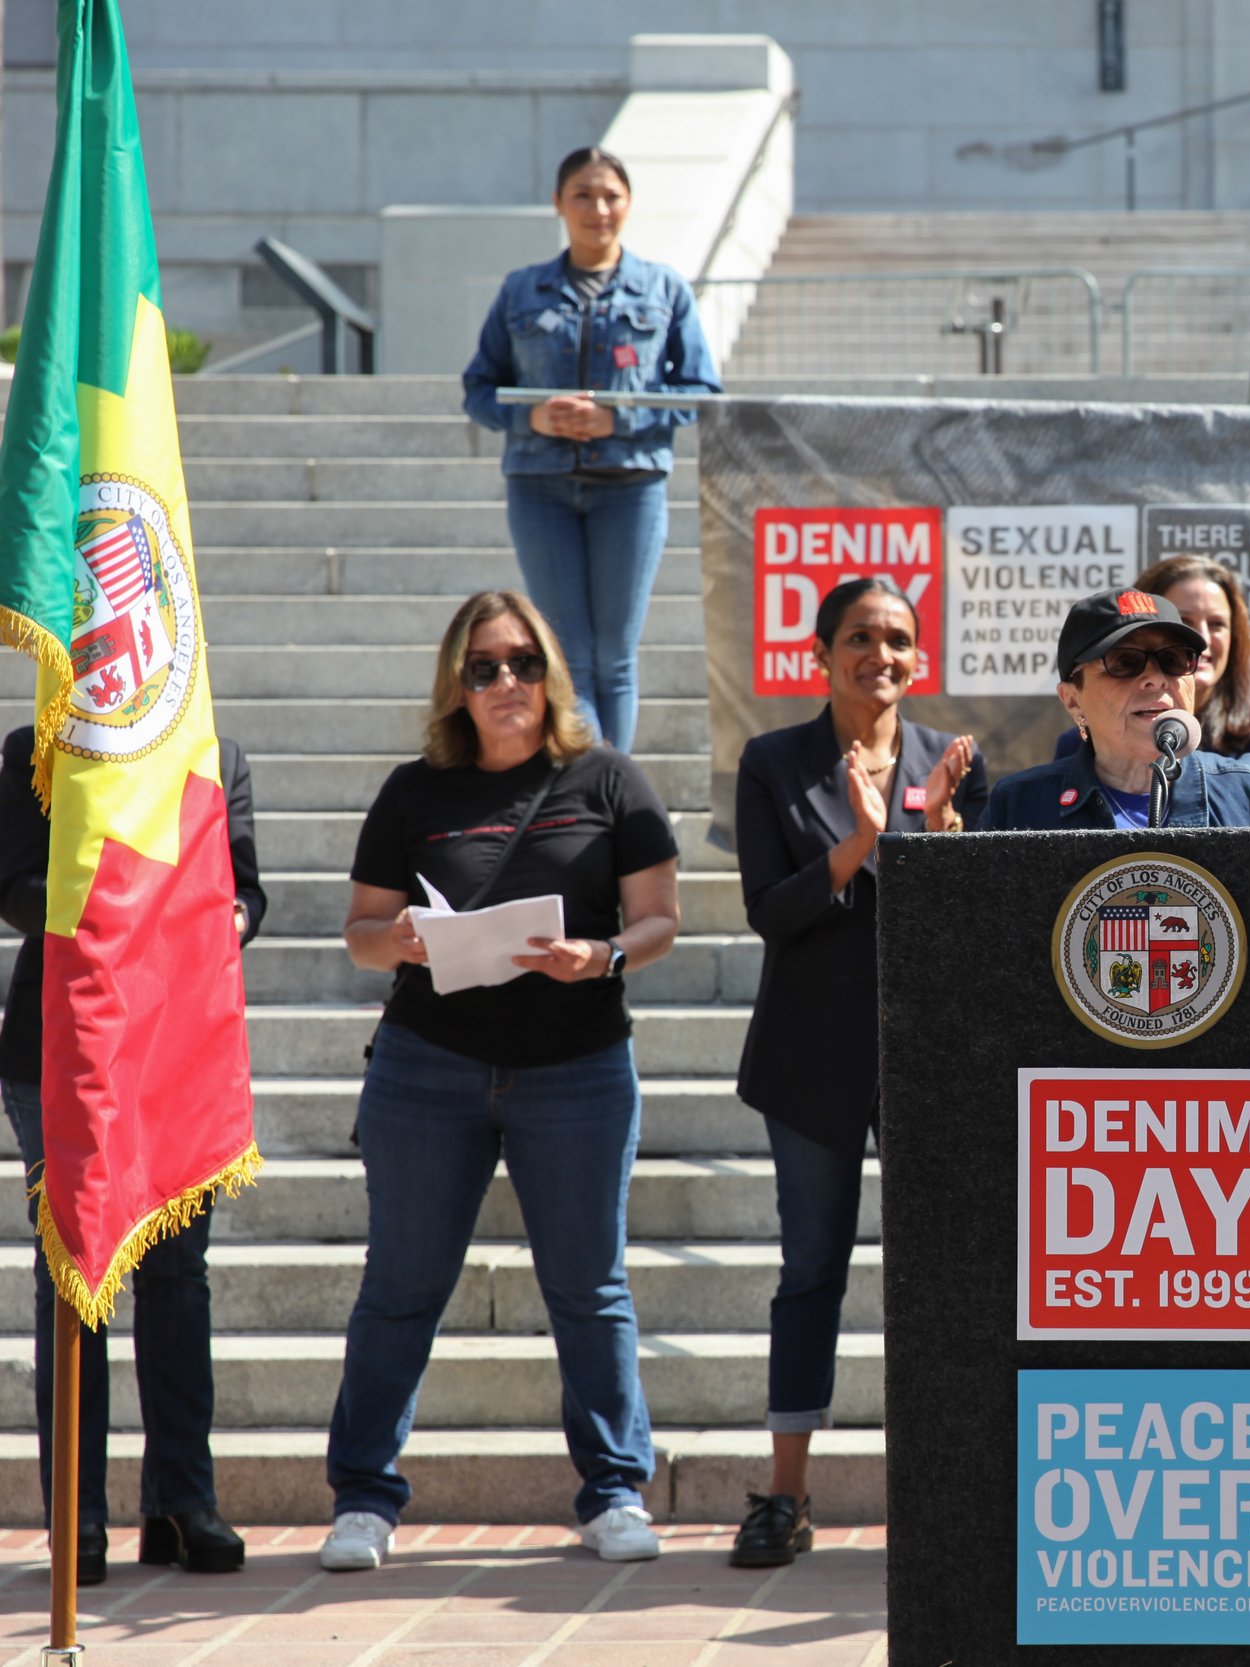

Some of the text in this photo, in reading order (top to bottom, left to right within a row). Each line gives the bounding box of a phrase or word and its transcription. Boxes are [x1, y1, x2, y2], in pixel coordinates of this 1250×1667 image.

[764, 522, 931, 565] DENIM
[961, 525, 1125, 556] SEXUAL
[1158, 524, 1244, 548] THERE
[962, 565, 1124, 590] VIOLENCE
[98, 486, 147, 511] CITY
[164, 595, 192, 708] ANGELES
[764, 573, 932, 643] DY
[961, 629, 1002, 643] AND
[1079, 871, 1220, 921] CITY OF LOS ANGELES
[1102, 1005, 1197, 1030] FOUNDED 1781
[1045, 1269, 1140, 1308] EST.
